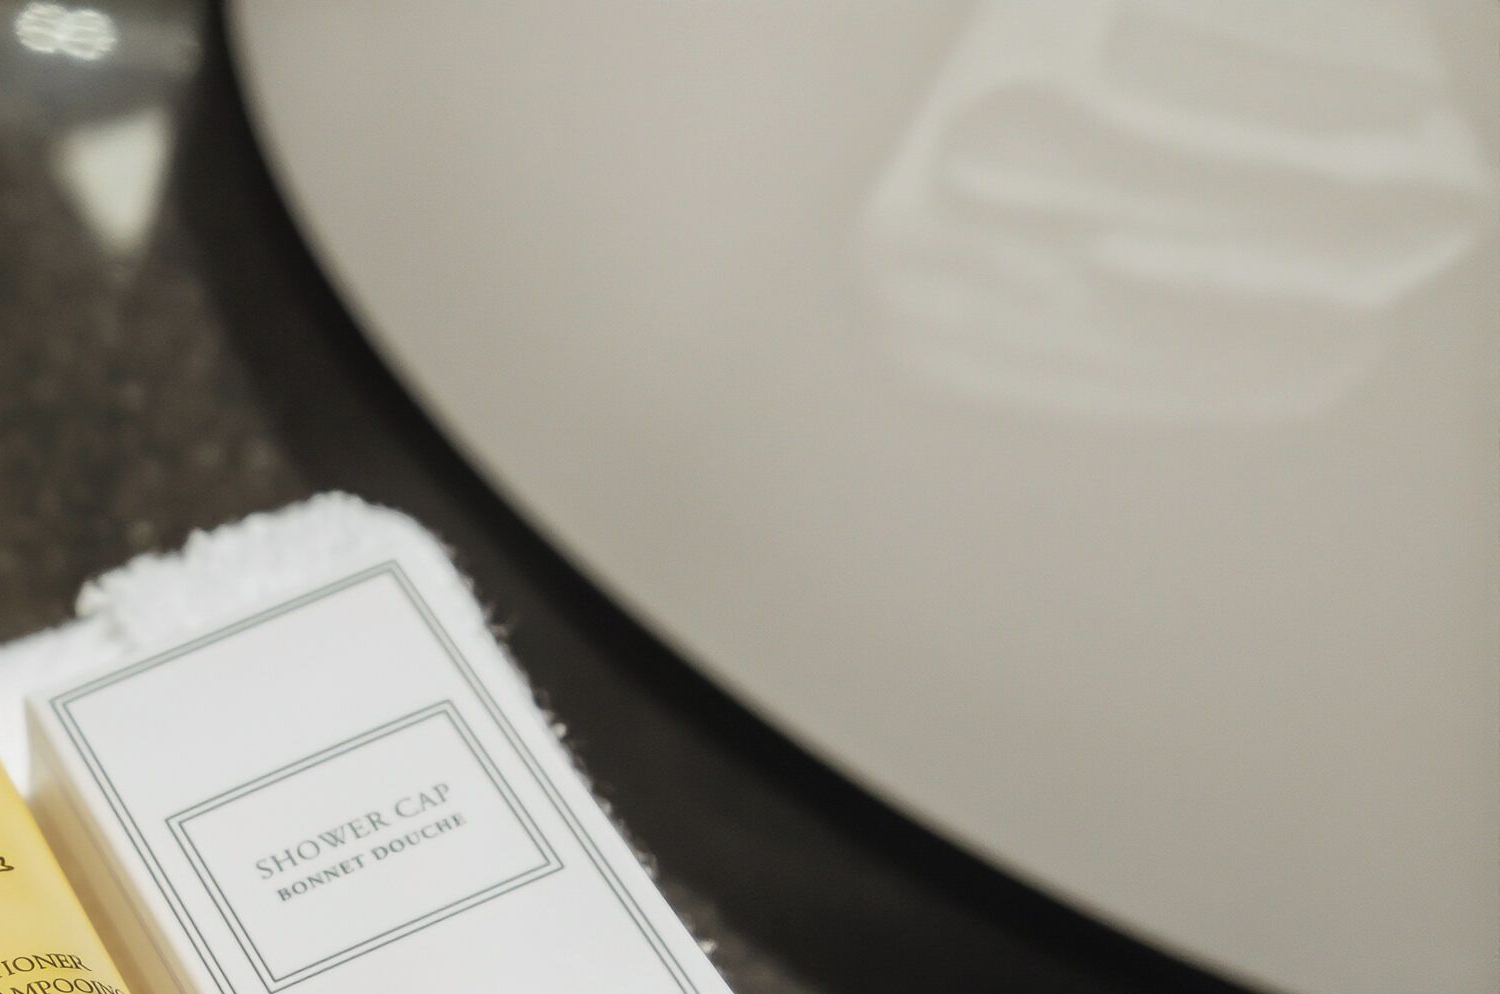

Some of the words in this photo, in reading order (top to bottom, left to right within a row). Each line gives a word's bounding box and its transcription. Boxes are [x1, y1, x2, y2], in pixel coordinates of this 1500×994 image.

[255, 810, 392, 881] SHOWER
[394, 782, 451, 819] CAP
[276, 853, 366, 902] BONNET
[371, 812, 468, 861] DOUCHE
